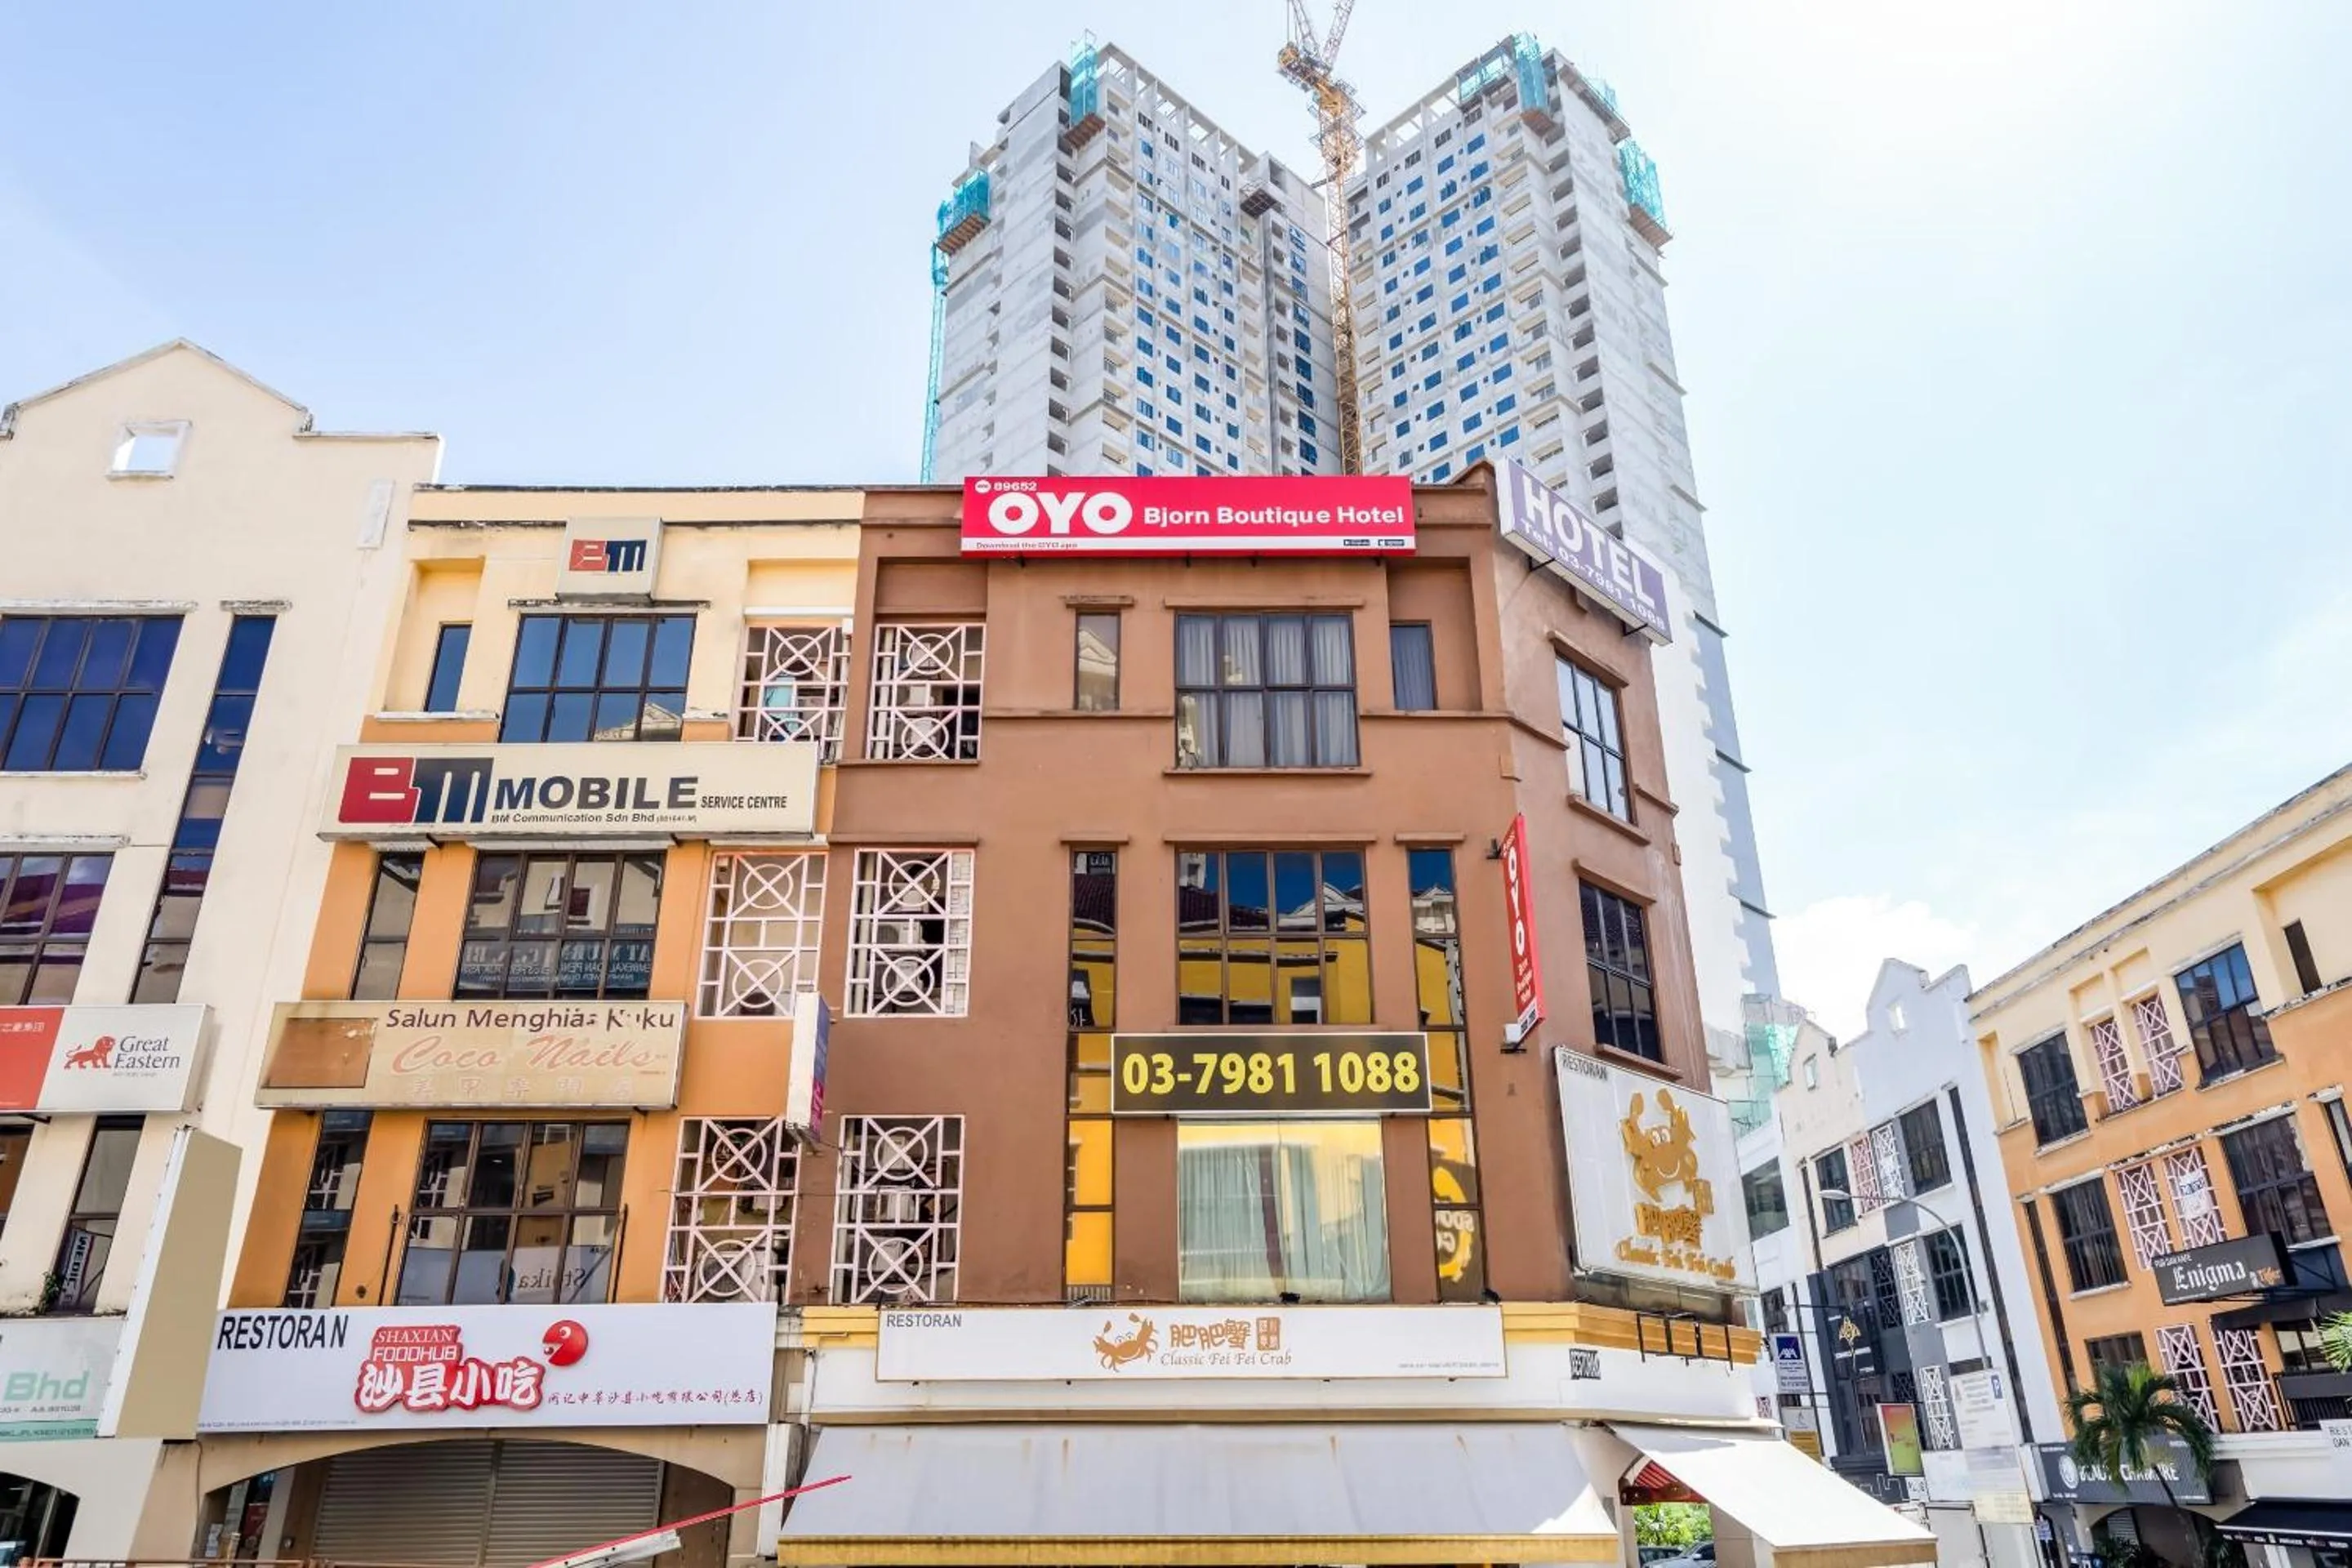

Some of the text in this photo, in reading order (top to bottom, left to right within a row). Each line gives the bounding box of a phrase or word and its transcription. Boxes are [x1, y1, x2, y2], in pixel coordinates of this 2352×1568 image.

[993, 481, 1037, 491] 89652
[988, 492, 1133, 534] OYO
[1143, 506, 1404, 527] Bjorn Boutique Hotel
[1522, 474, 1655, 609] HOTEL
[494, 776, 699, 810] MOBILE
[701, 796, 744, 808] SERVICE
[747, 796, 787, 808] CENTRE
[491, 814, 510, 823] BM
[513, 814, 602, 823] Communication
[605, 813, 629, 822] Sdn
[631, 813, 654, 822] Bhd
[1508, 847, 1525, 956] OYO
[386, 1009, 457, 1027] Salun
[119, 1036, 169, 1053] Great
[392, 1036, 500, 1073] Coco
[527, 1035, 653, 1069] Nails
[114, 1053, 180, 1069] Eastern
[1122, 1051, 1420, 1094] 03-7981 1088
[2172, 1260, 2246, 1291] Enigma
[217, 1315, 349, 1349] RESTORAN
[887, 1313, 962, 1327] RESTORAN
[376, 1328, 456, 1344] SHAXIAN
[1169, 1318, 1251, 1351] 肥肥蟹
[373, 1346, 457, 1362] FOODHUB
[1160, 1352, 1292, 1366] Classic Fei Fei Crab
[1780, 1348, 1798, 1359] AXA
[4, 1370, 90, 1401] Bhd
[360, 1361, 541, 1406] 沙县小吃
